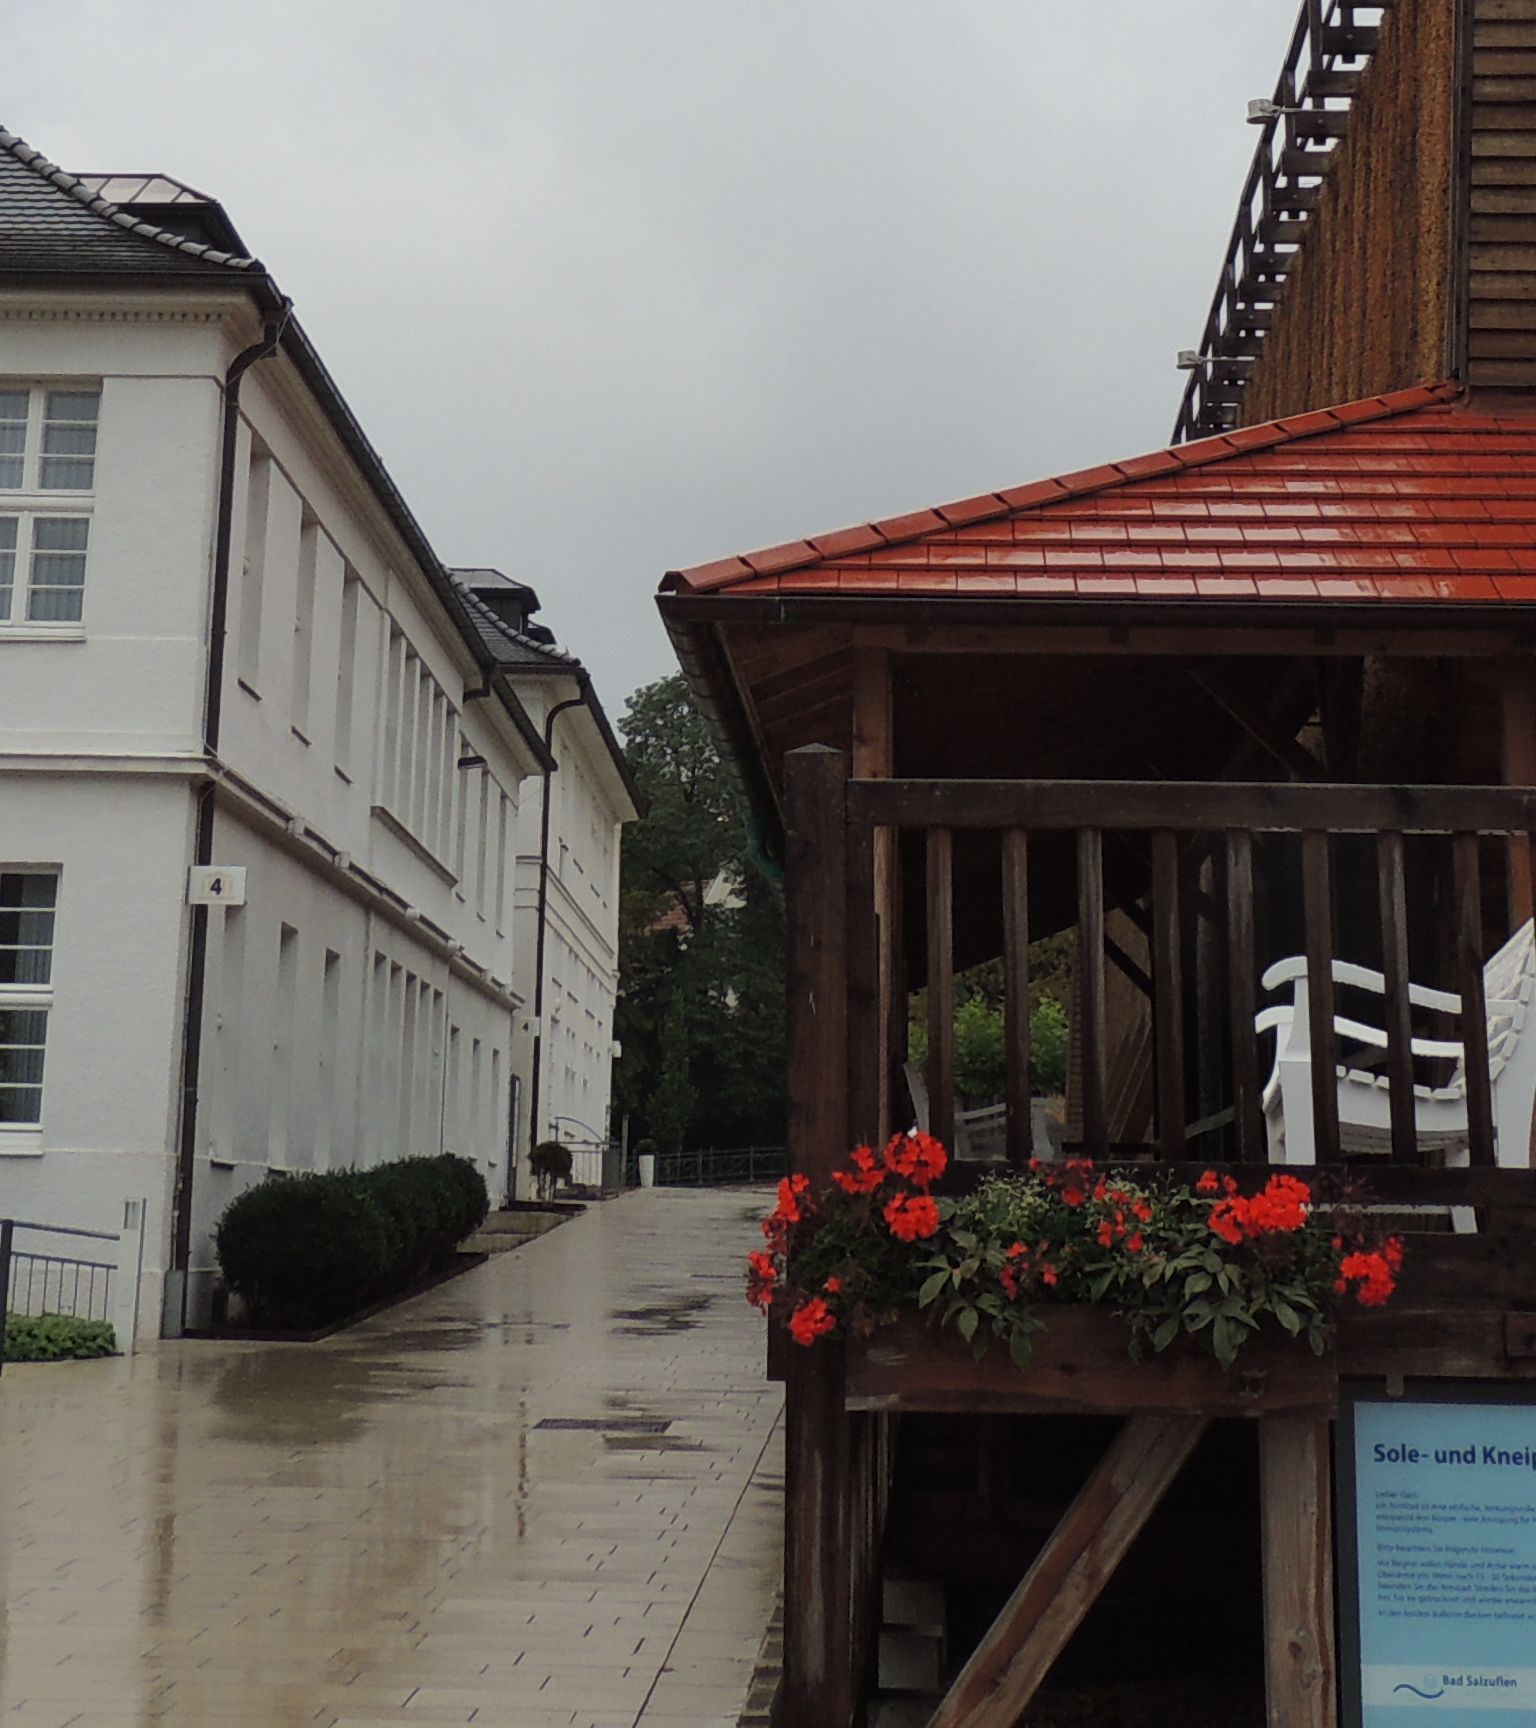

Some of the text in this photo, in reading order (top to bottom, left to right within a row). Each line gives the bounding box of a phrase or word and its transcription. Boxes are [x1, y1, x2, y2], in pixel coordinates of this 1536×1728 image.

[210, 877, 222, 896] 4
[521, 1021, 529, 1032] 4
[1373, 1443, 1429, 1464] Sole-
[1434, 1444, 1476, 1465] und
[1442, 1674, 1518, 1688] Bad Salzuflen
